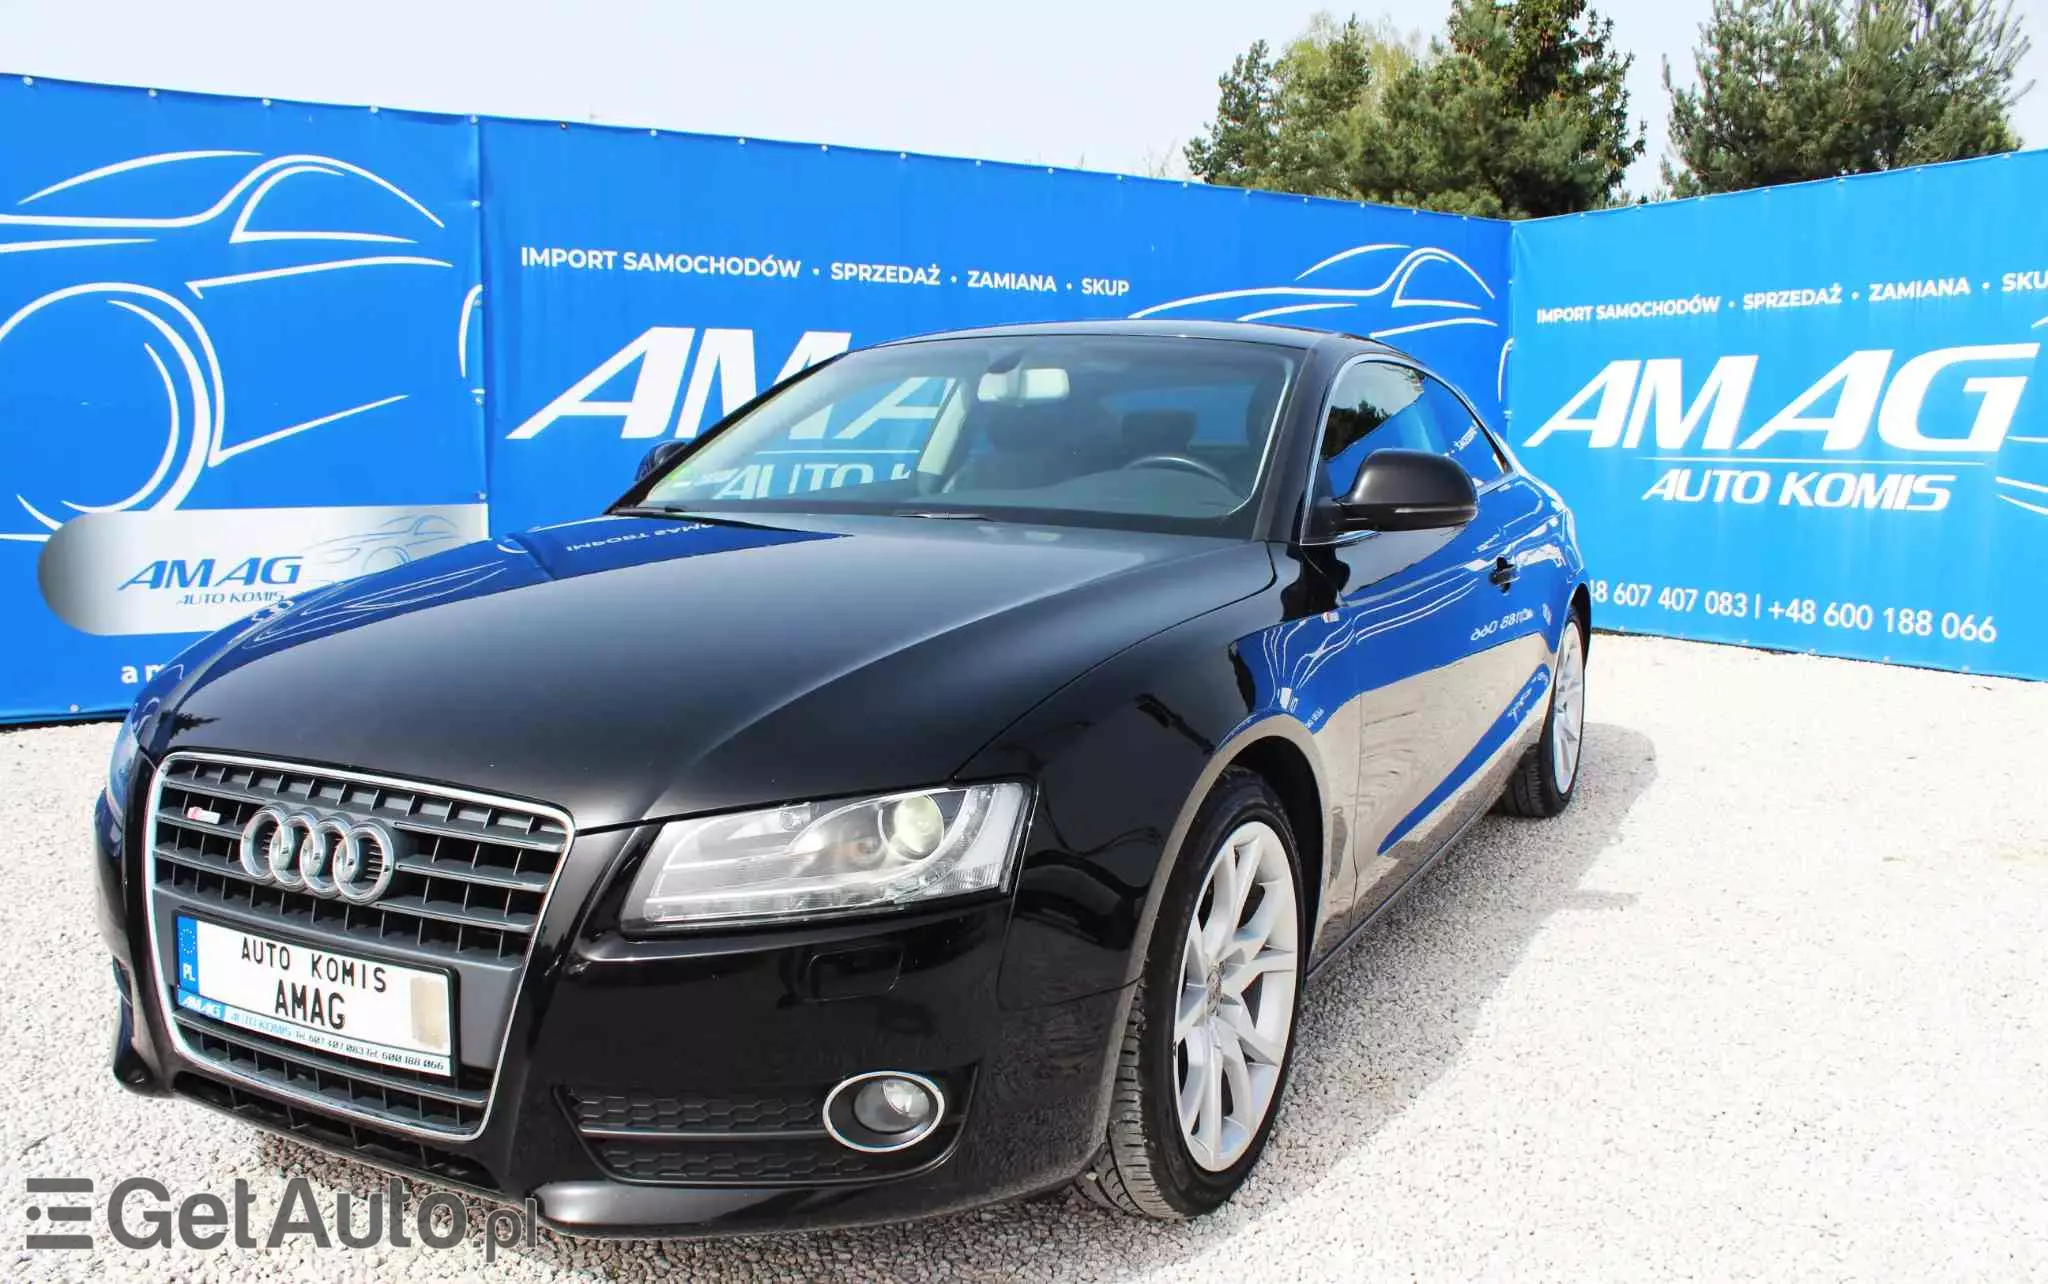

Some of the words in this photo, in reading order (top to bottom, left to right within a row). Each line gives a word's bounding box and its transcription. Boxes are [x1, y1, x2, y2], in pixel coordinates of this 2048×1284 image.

[521, 247, 618, 270] IMPORT
[623, 251, 801, 278] SAMOCHODÓW
[831, 262, 941, 285] SPRZEDAŻ
[967, 270, 1057, 292] ZAMIANA
[1081, 278, 1130, 296] SKUP
[1536, 305, 1593, 324] IMPORT
[1596, 294, 1720, 320] SAMOCHODÓW
[1743, 283, 1842, 310] SPRZEDAŻ
[1869, 277, 1971, 302] ZAMIANA
[1642, 468, 1771, 505] AUTO
[1779, 471, 1956, 512] KOMIS
[176, 593, 225, 606] AUTO
[229, 590, 286, 604] KOMIS
[1613, 582, 1652, 607] 607
[1658, 586, 1698, 612] 407
[1705, 590, 1748, 617] 083
[1768, 598, 1817, 625] +48
[1824, 602, 1873, 630] 600
[1883, 607, 1933, 636] 188
[1942, 612, 1997, 643] 066
[183, 963, 196, 982] PL
[241, 937, 291, 970] AUTO
[311, 953, 387, 992] KOMIS
[275, 979, 346, 1030] AMAG
